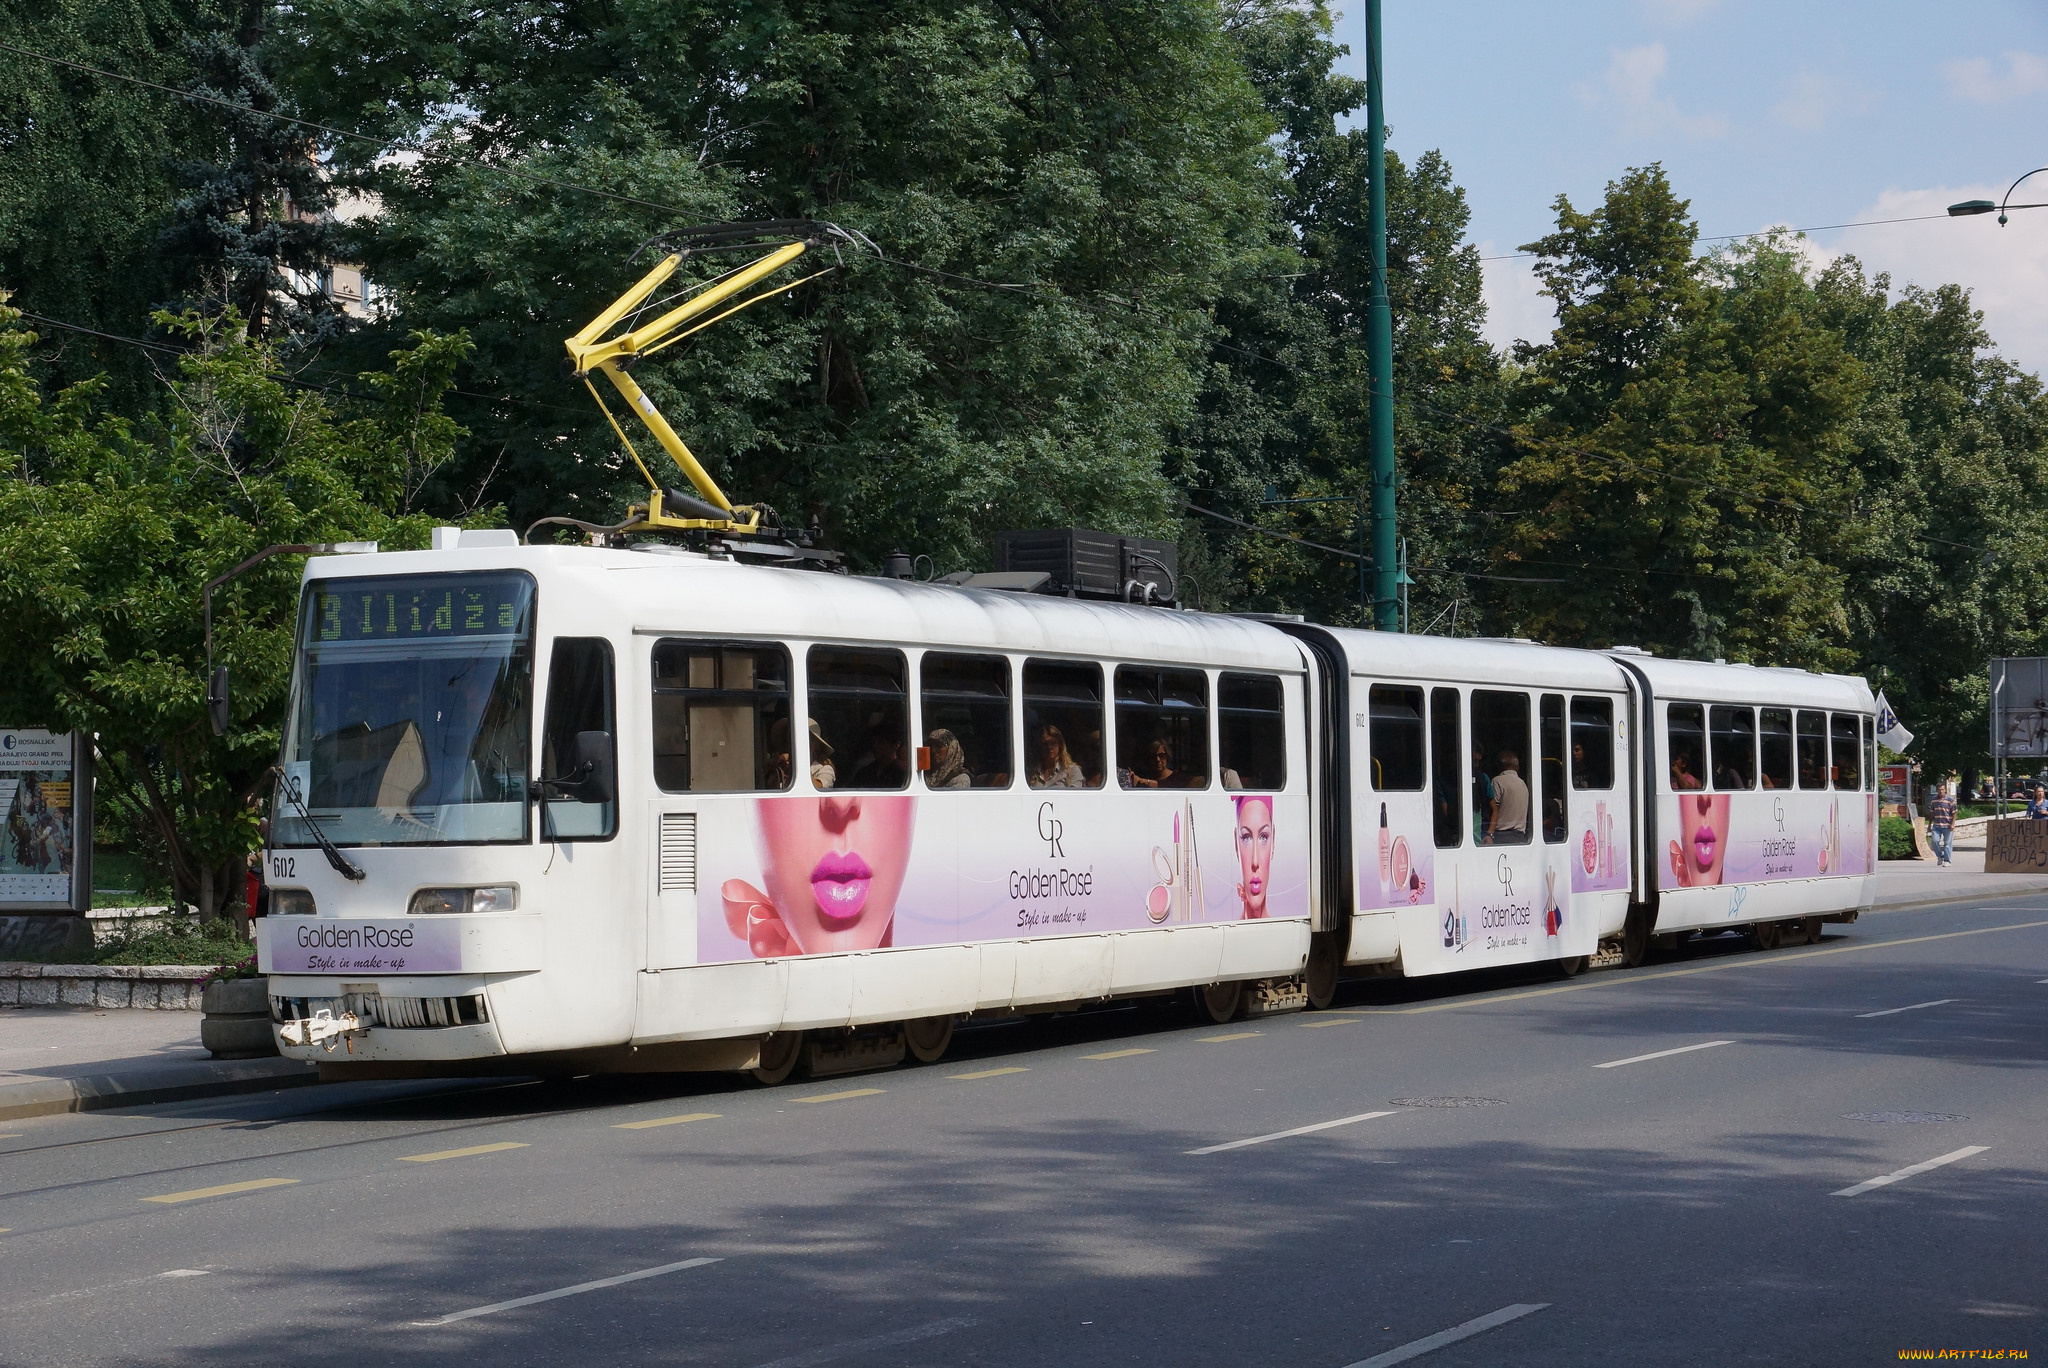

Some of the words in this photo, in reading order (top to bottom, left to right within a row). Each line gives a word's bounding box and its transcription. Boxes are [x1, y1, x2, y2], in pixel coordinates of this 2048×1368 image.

[320, 594, 341, 640] 3
[362, 592, 515, 633] Ilidža
[1356, 713, 1364, 727] 602
[1763, 838, 1781, 857] Golden
[1782, 838, 1795, 855] Rose
[273, 857, 296, 878] 602
[1009, 867, 1058, 899] Golden
[1060, 868, 1092, 896] Rose
[1017, 909, 1039, 931] Style
[1042, 911, 1050, 924] in
[1052, 905, 1087, 926] make-up
[1482, 904, 1509, 928] Golden
[1511, 904, 1530, 925] Rose
[297, 924, 361, 948] Golden
[364, 925, 413, 948] Rose
[1487, 935, 1500, 952] Style
[308, 955, 336, 971] Style
[339, 955, 351, 968] in
[354, 955, 406, 971] make-up
